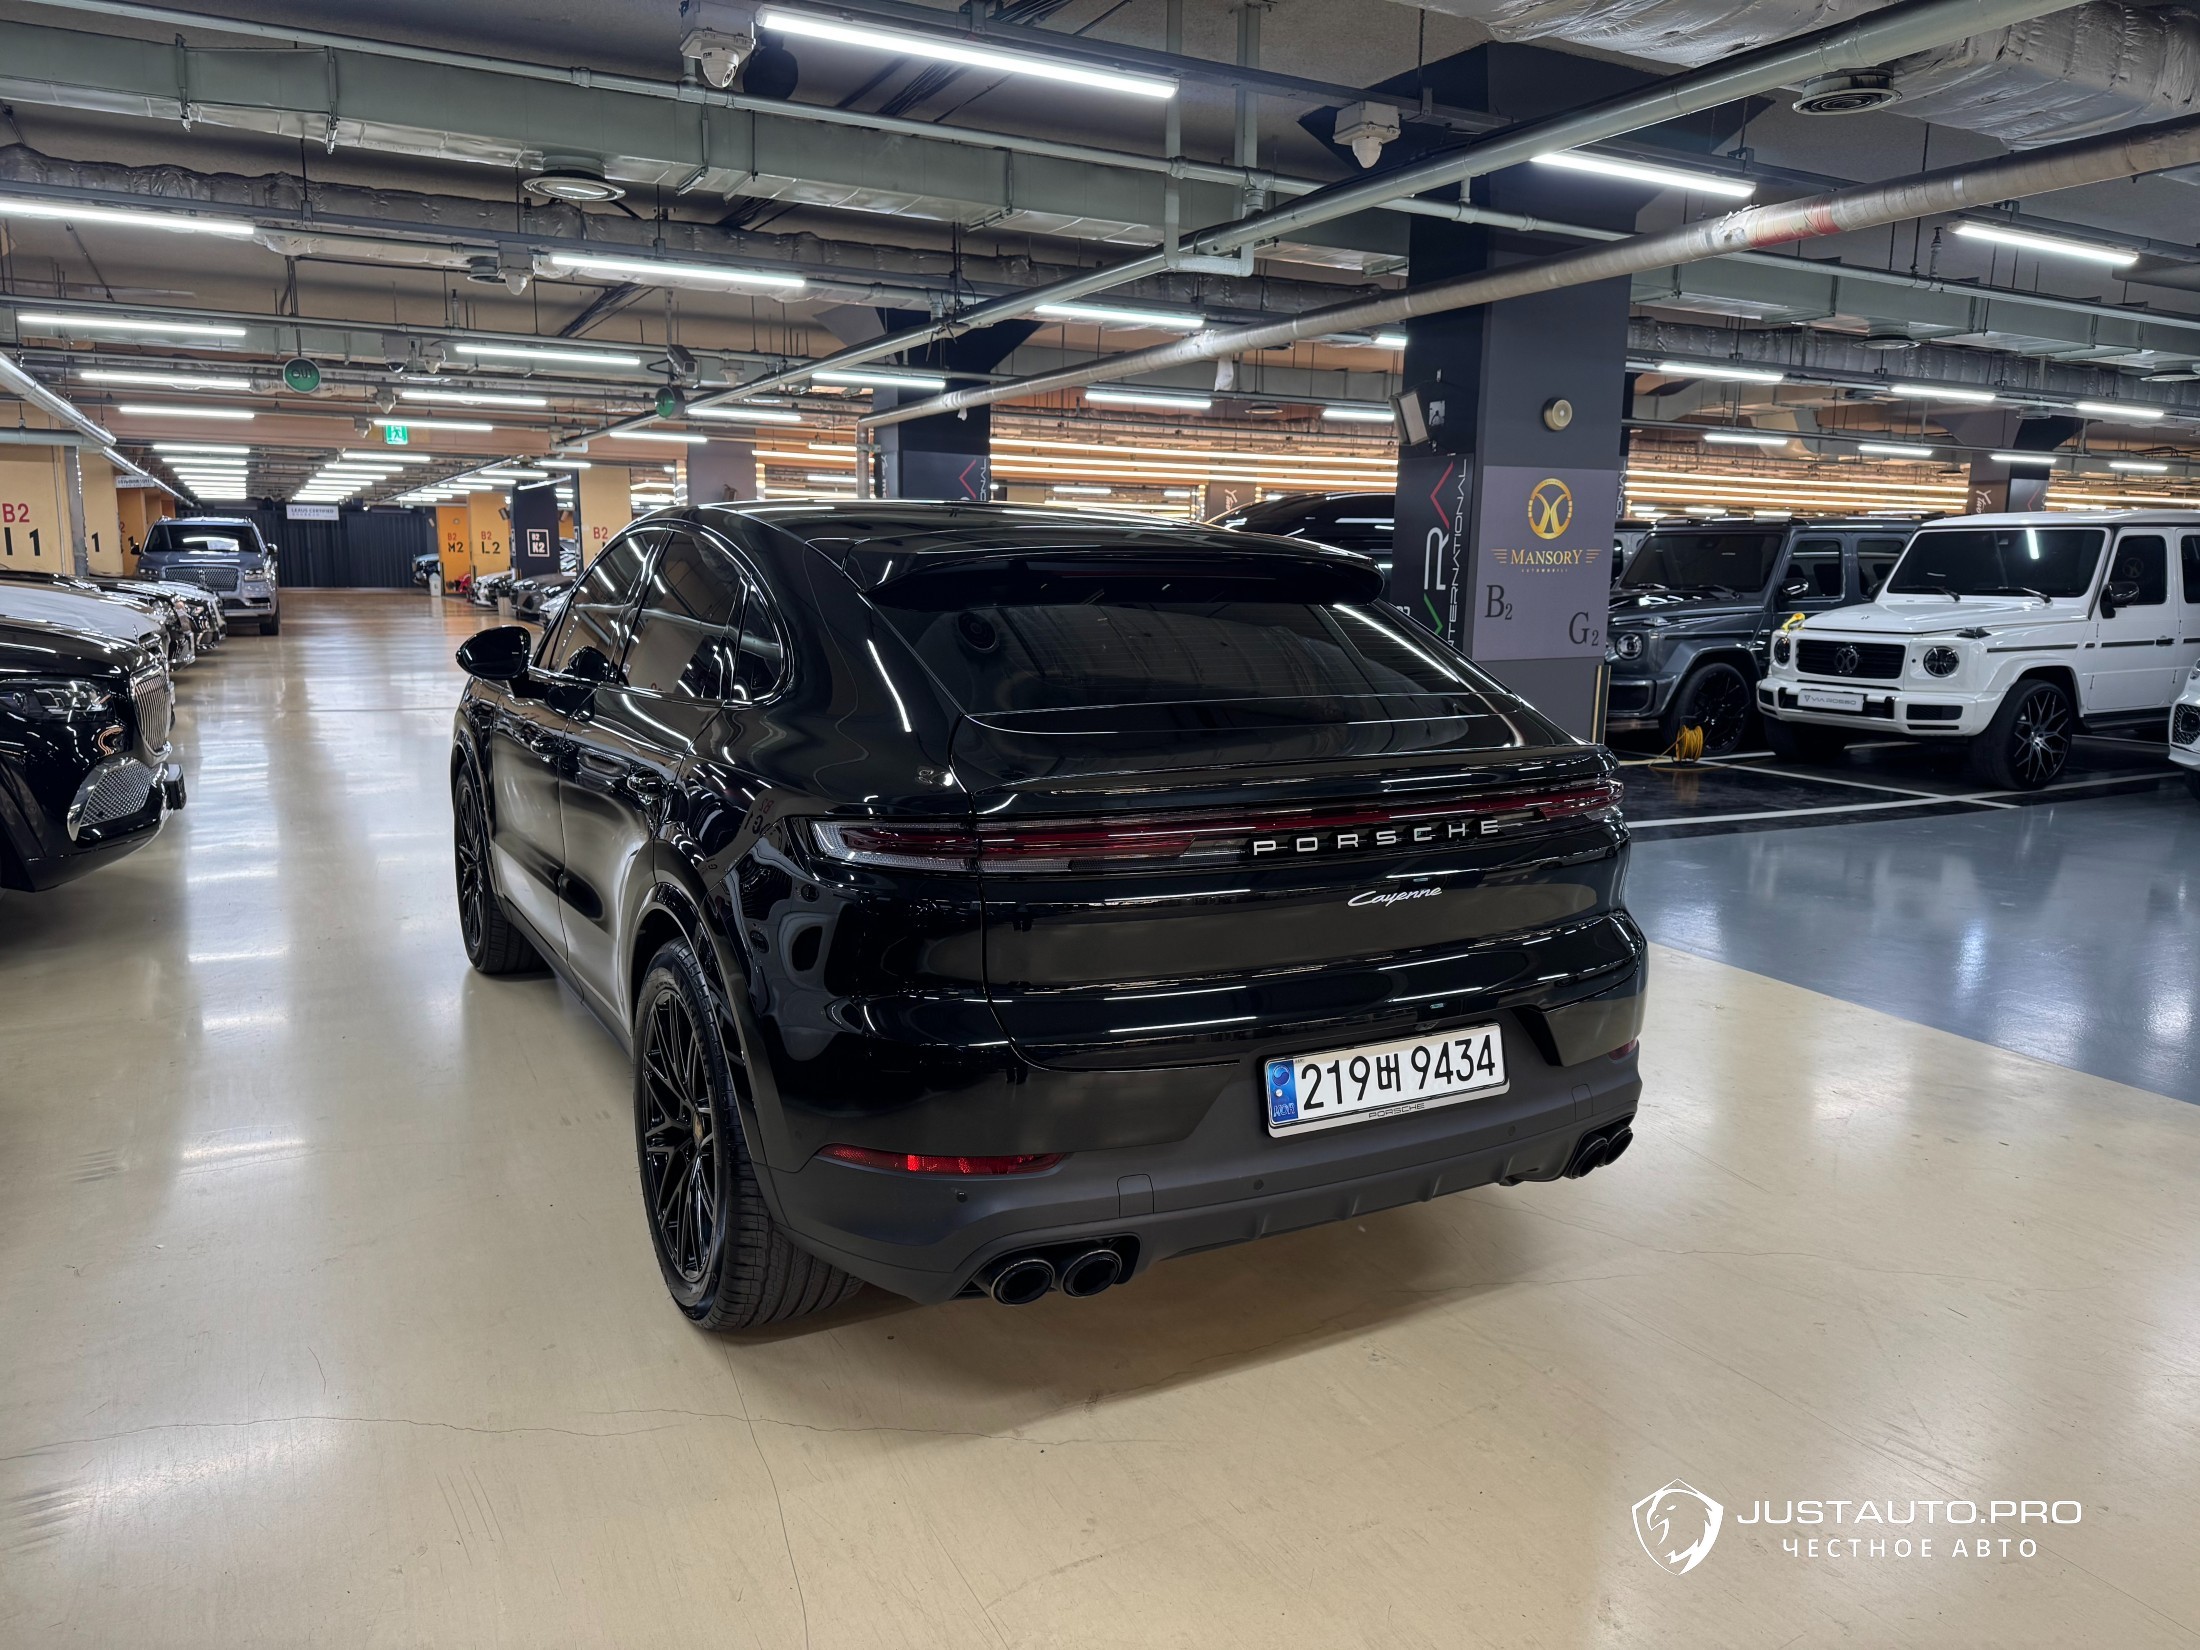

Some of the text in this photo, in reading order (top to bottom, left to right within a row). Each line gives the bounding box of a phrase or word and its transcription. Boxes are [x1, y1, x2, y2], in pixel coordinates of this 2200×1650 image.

[2, 503, 30, 523] B2
[447, 532, 457, 541] B2
[481, 531, 492, 540] B2
[593, 527, 608, 539] B2
[447, 542, 464, 553] M2
[532, 542, 546, 553] K2
[1510, 549, 1583, 565] MANSORY
[1253, 819, 1499, 856] PORSCHE
[1347, 885, 1443, 907] Cayenne
[1301, 1034, 1496, 1111] 219버 9434
[1368, 1102, 1425, 1120] PORSCHE
